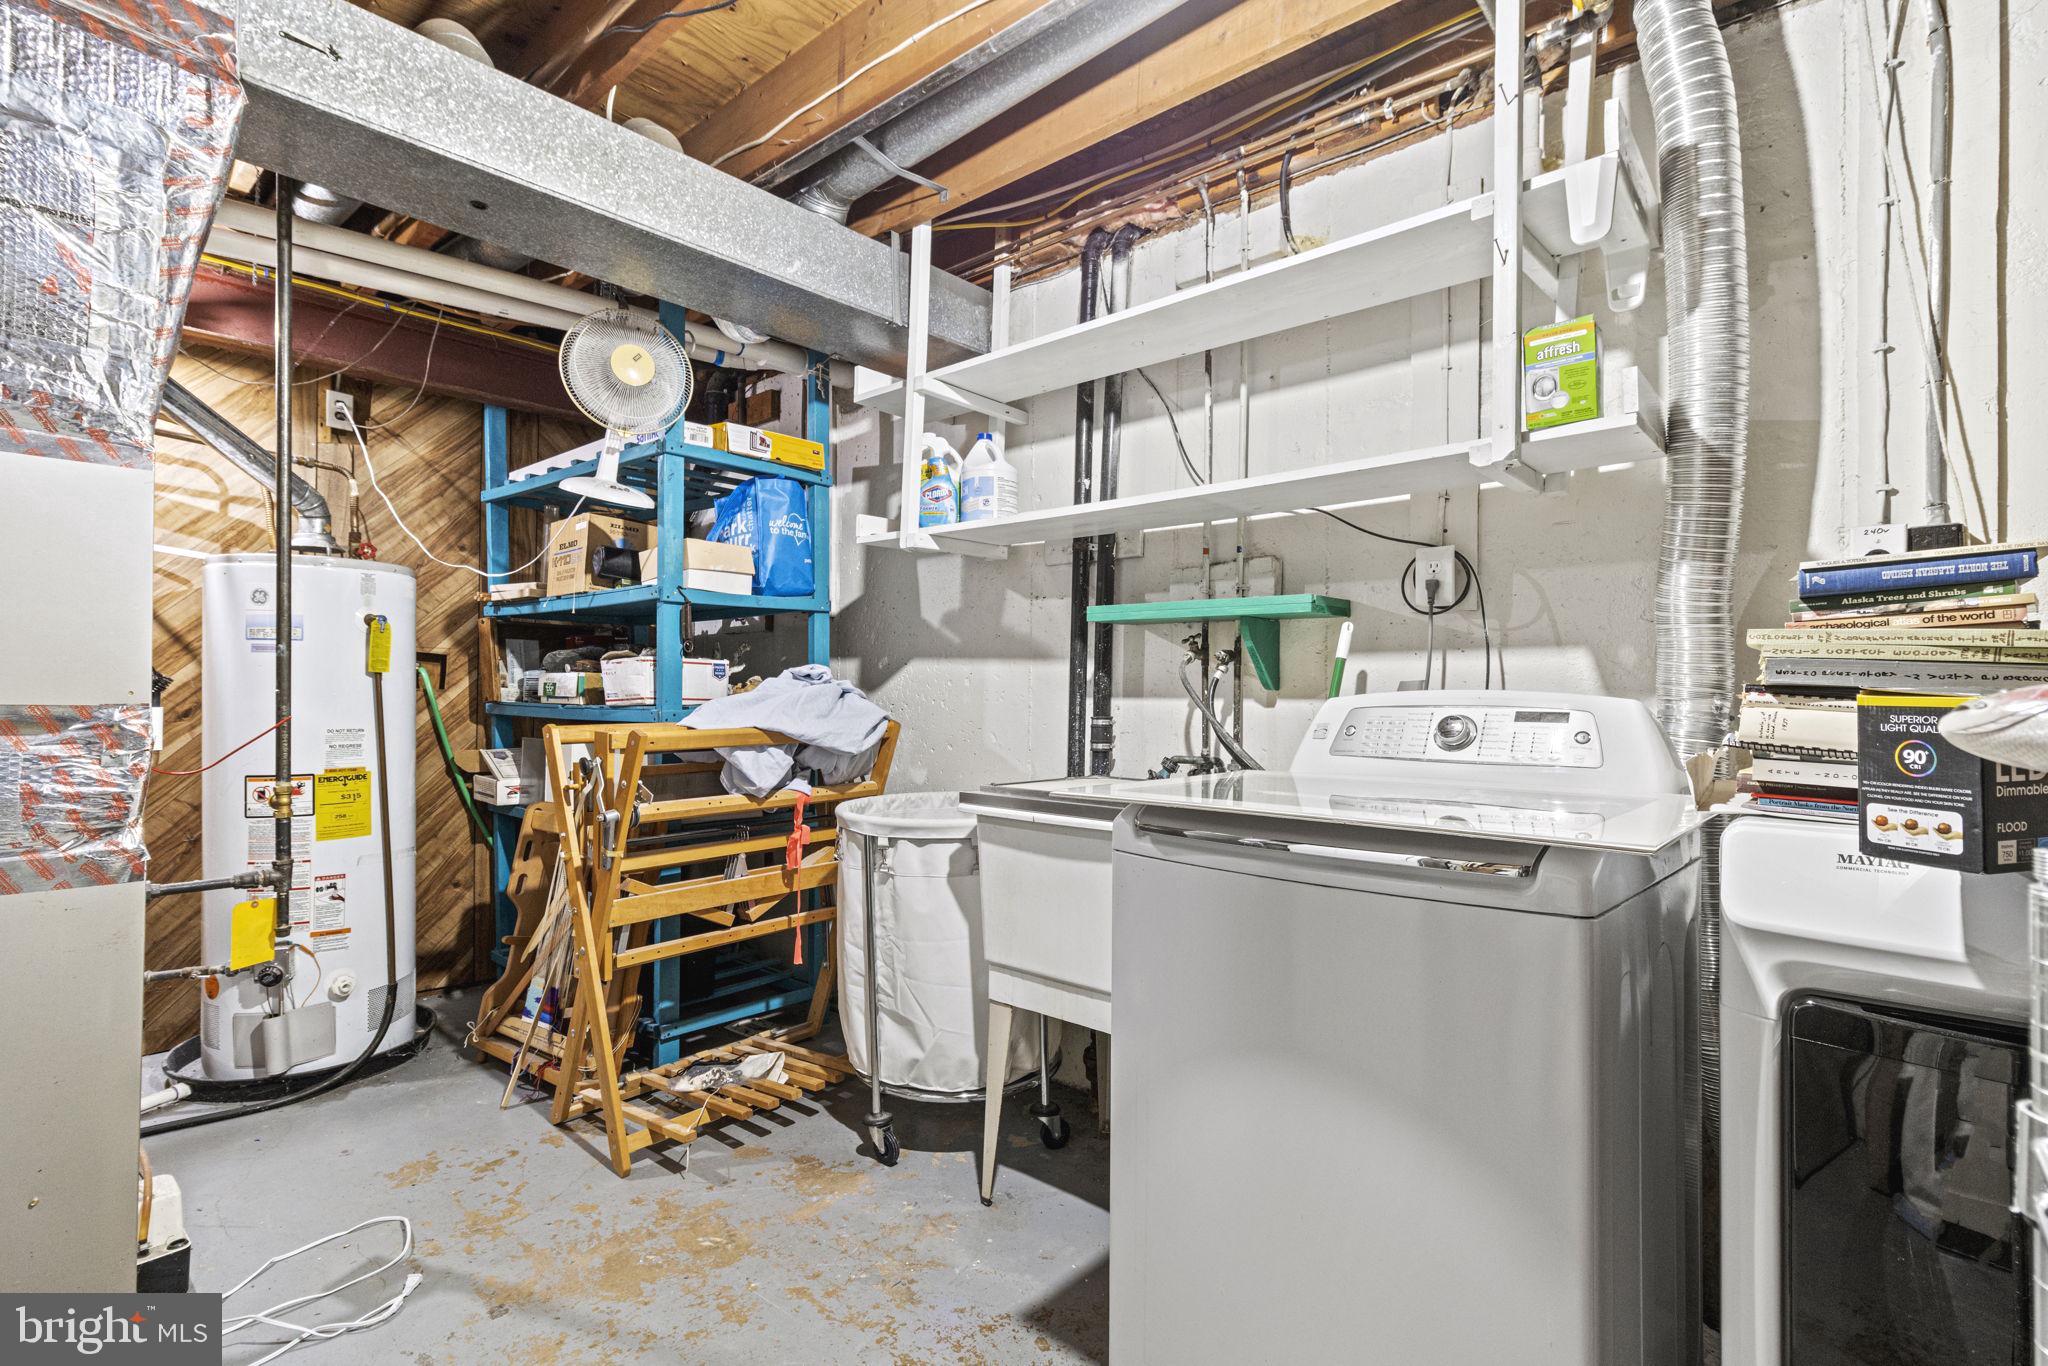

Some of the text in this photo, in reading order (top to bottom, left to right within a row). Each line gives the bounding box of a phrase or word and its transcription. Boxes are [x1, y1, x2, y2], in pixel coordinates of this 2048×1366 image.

[1537, 341, 1580, 360] affresh
[610, 524, 639, 533] ELMO
[724, 513, 748, 538] ark
[769, 516, 803, 531] welcome
[782, 527, 794, 537] the
[560, 540, 578, 551] ELMO
[1882, 561, 2009, 580] THE NORTH ALASKAN ESKIMO
[1842, 588, 1967, 605] Alaska Trees and Shrubs
[1810, 618, 1890, 629] archaeological
[1923, 615, 1935, 624] of
[1938, 613, 1957, 623] the
[1960, 611, 1996, 622] world
[1822, 670, 1898, 678] PREHISTORY
[1890, 715, 1938, 725] SUPERIOR
[1880, 724, 1940, 734] LIGHT QUAL
[1997, 784, 2048, 798] Dimmable
[1909, 810, 1939, 818] Difference
[1997, 822, 2028, 833] FLOOD
[1837, 854, 1910, 869] MAYTAG
[1836, 866, 1872, 874] COMMERCIAL
